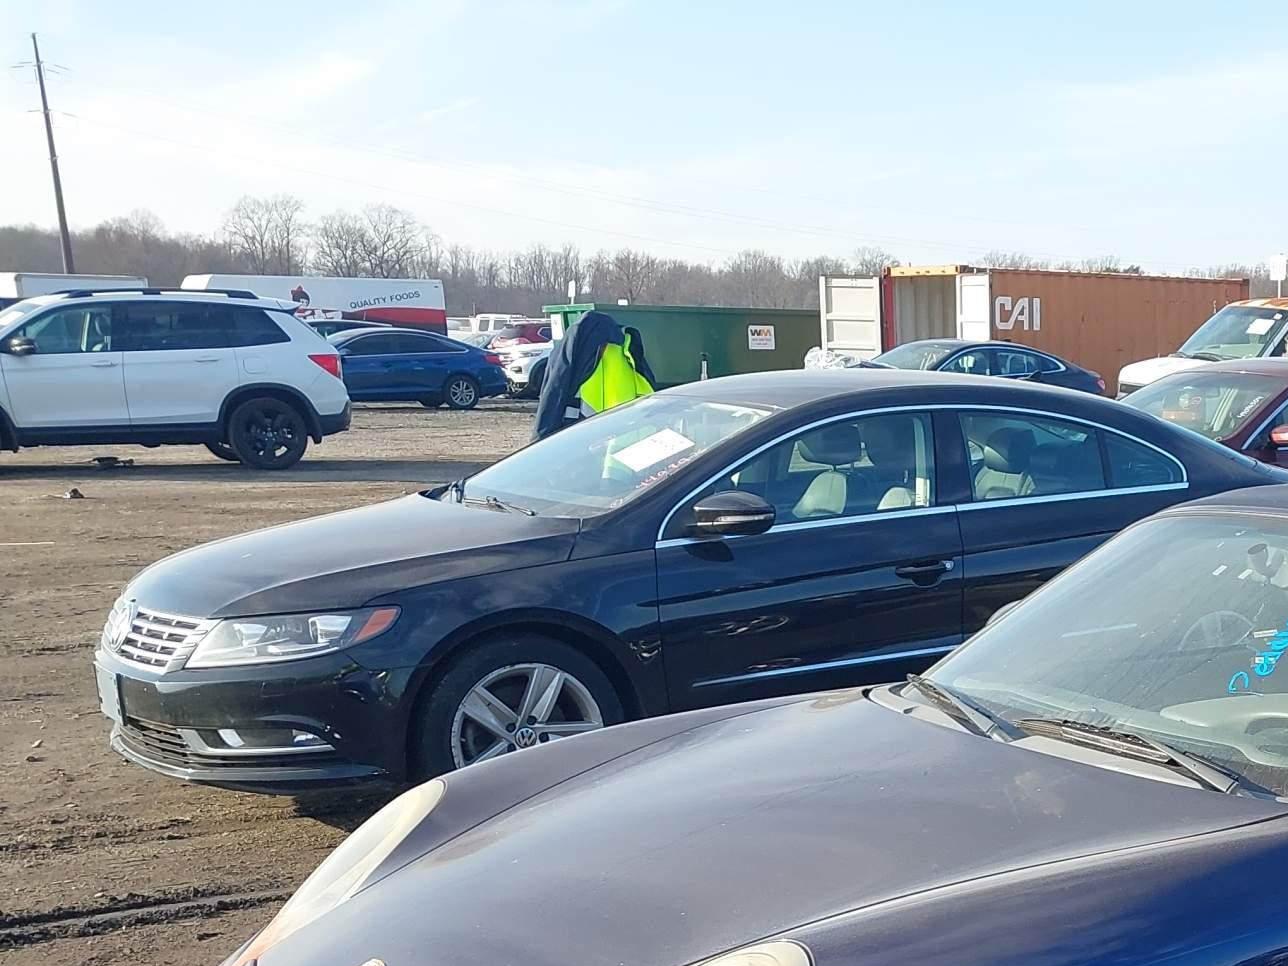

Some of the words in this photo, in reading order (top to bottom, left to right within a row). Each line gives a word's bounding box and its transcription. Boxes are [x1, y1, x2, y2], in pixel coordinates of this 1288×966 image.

[349, 295, 387, 309] QUALITY
[389, 290, 421, 302] FOODS
[995, 296, 1041, 331] CAI
